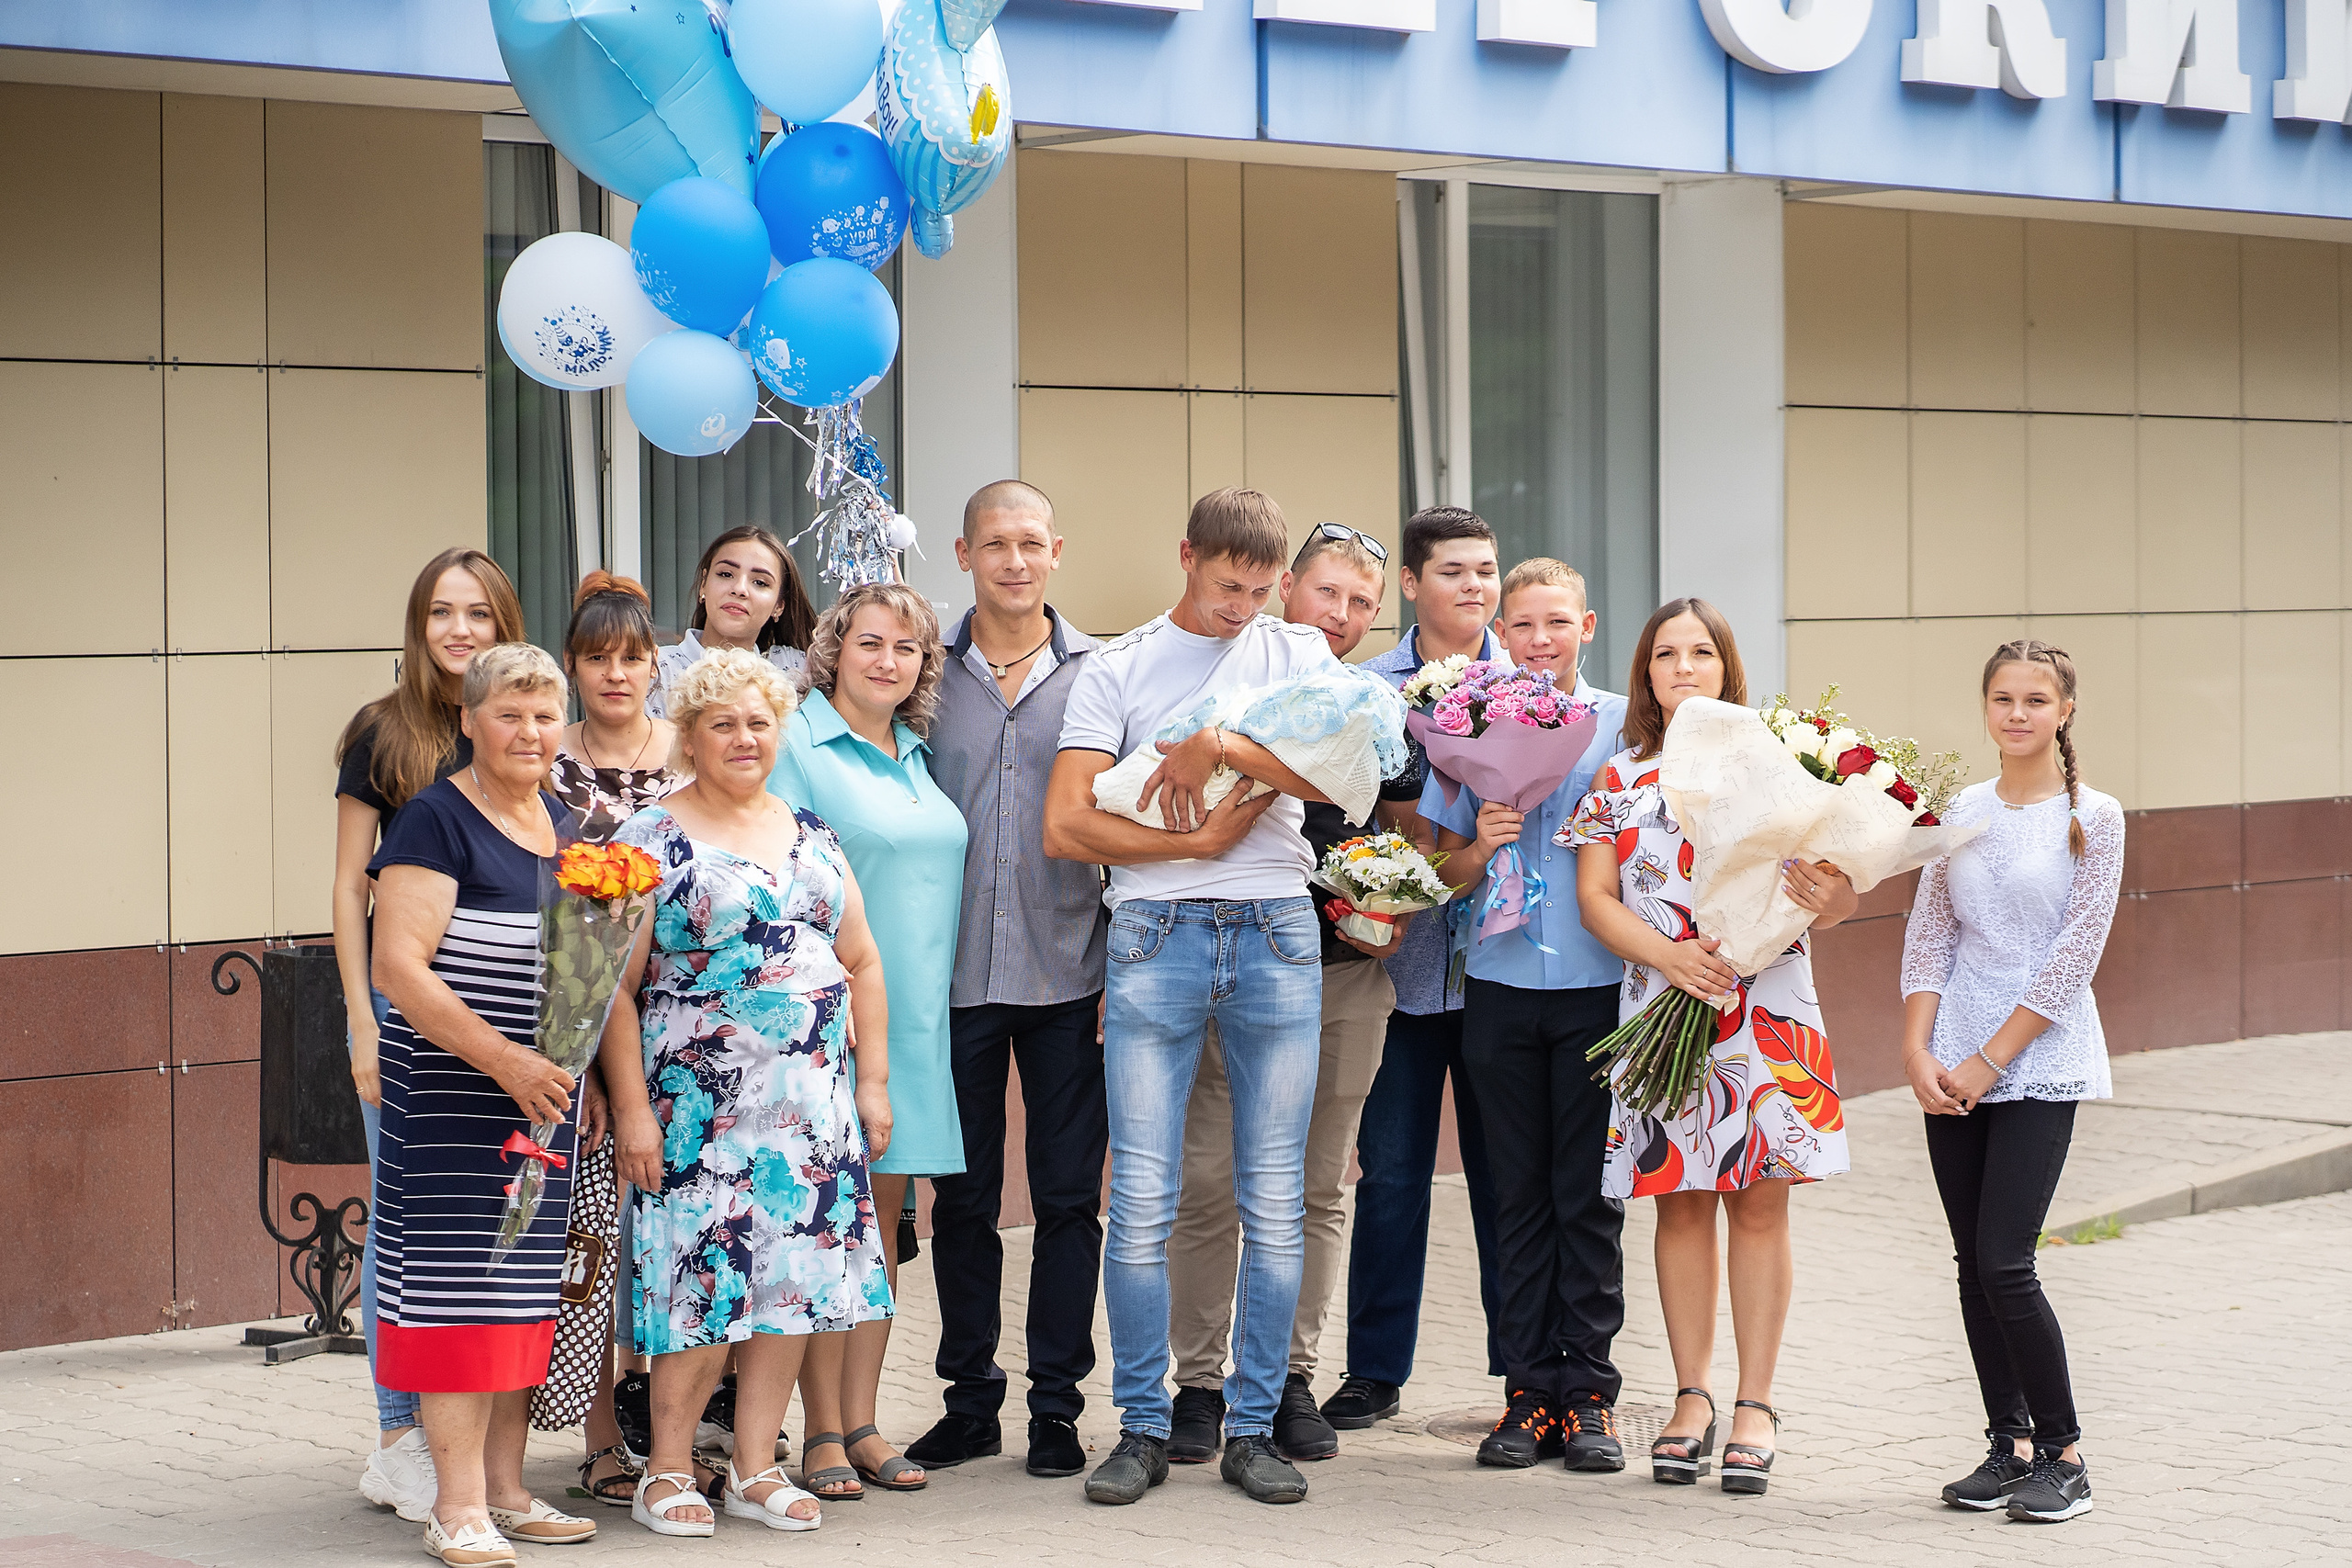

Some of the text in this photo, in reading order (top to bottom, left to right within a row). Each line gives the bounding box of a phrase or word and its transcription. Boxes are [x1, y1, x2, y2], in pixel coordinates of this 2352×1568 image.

[878, 81, 899, 137] Boy!
[849, 226, 876, 245] УРА!
[564, 325, 613, 374] МАЛЬЧИК
[627, 1381, 643, 1393] CK
